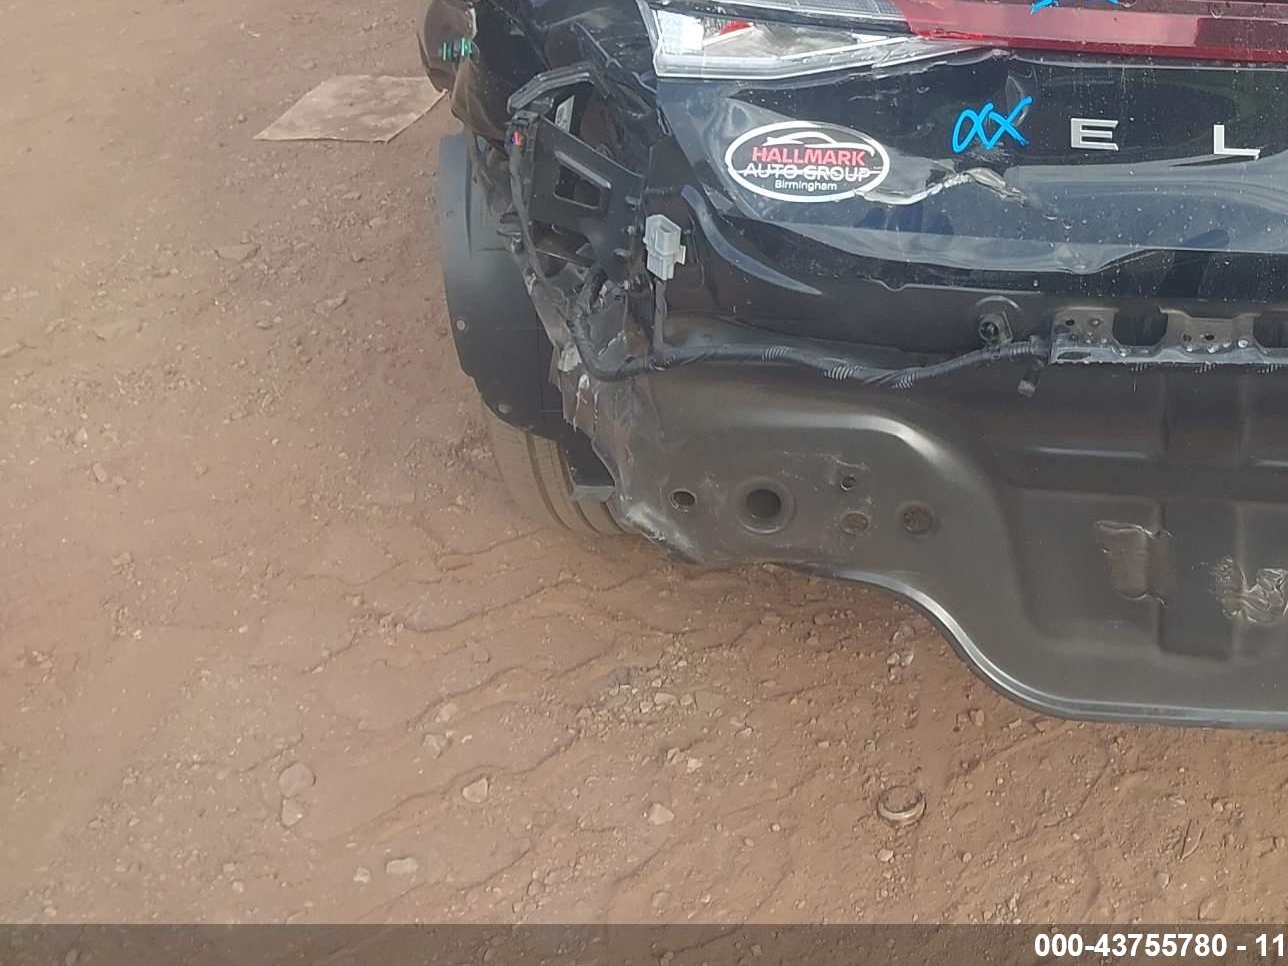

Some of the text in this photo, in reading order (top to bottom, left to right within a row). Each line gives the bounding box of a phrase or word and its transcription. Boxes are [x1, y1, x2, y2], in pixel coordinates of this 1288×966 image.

[752, 146, 866, 166] HALLMARK
[743, 162, 871, 183] AUTO GROUP
[774, 179, 838, 192] Birmingham
